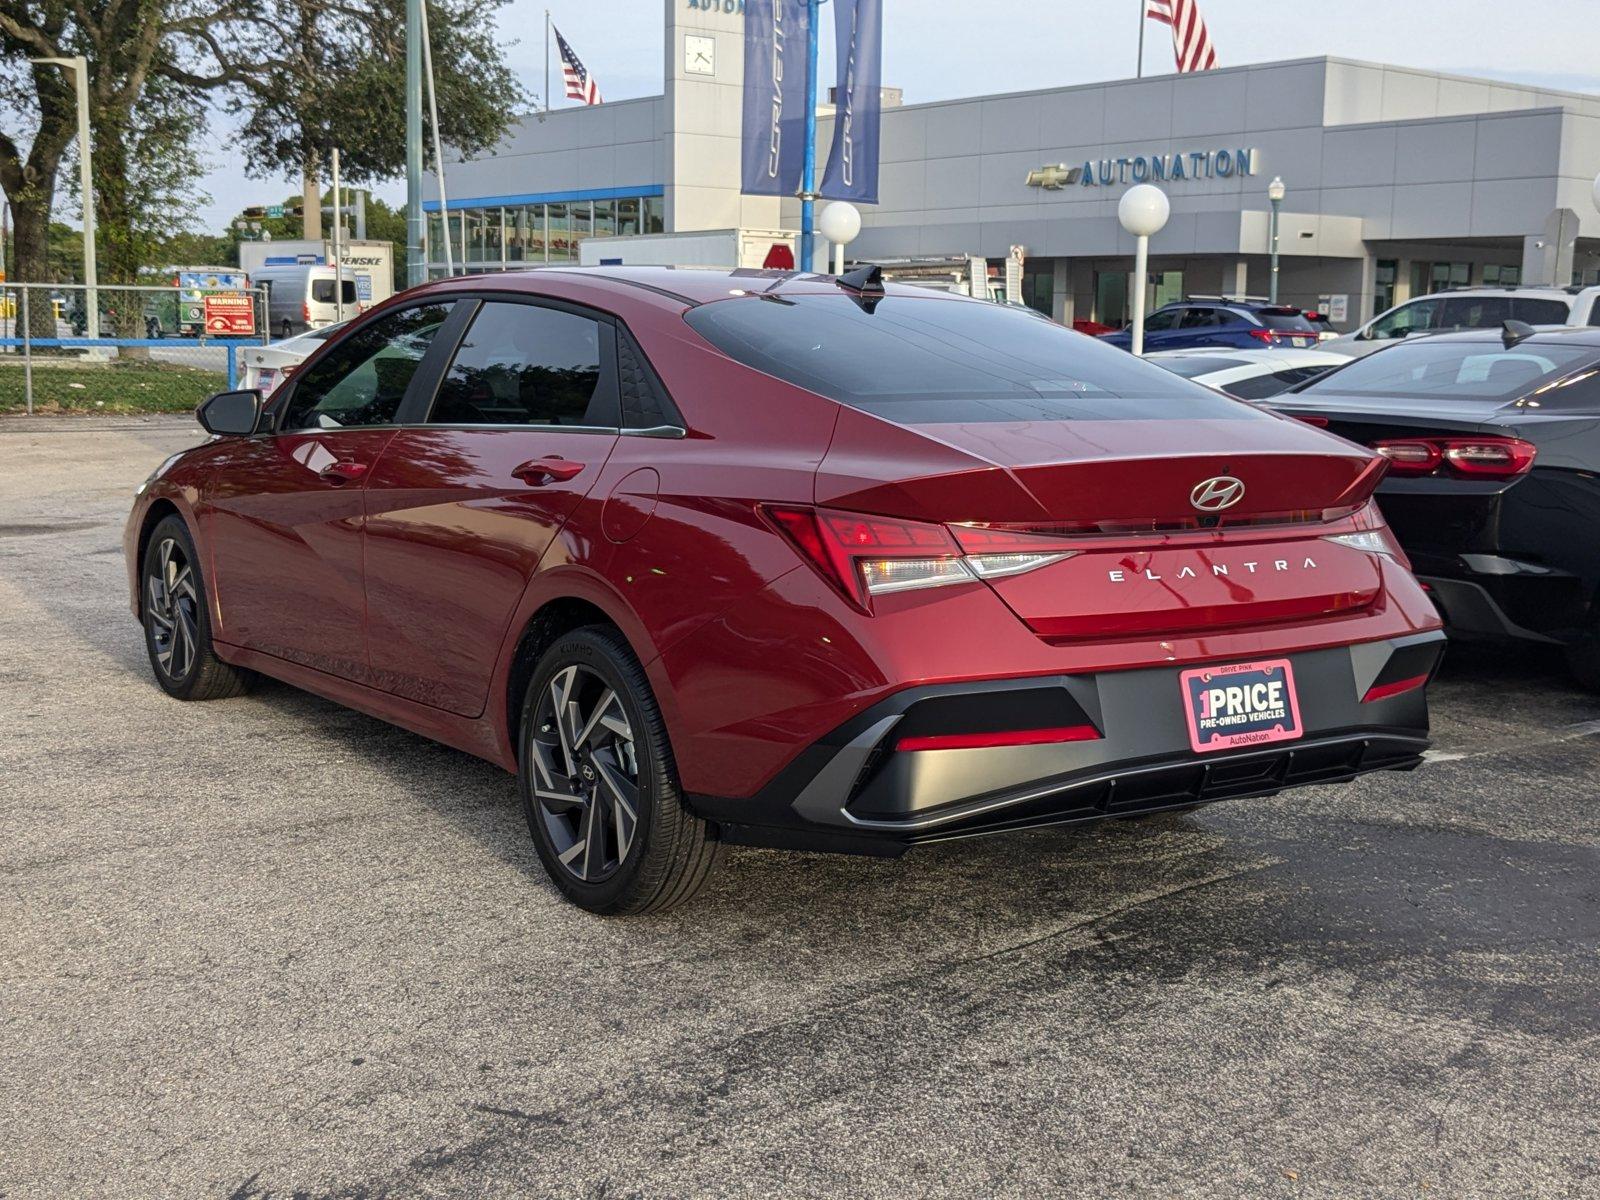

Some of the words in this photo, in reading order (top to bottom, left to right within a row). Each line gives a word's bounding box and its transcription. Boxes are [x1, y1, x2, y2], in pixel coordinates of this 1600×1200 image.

[1081, 148, 1258, 187] AUTONATION
[208, 298, 249, 306] WARNING
[1109, 557, 1317, 583] ELANTRA
[1220, 664, 1237, 674] DRIVE
[1238, 663, 1253, 673] PINK
[1200, 714, 1248, 729] PRE-OWNED
[1248, 708, 1286, 722] VEHICLES
[1229, 733, 1270, 746] AutoNation
